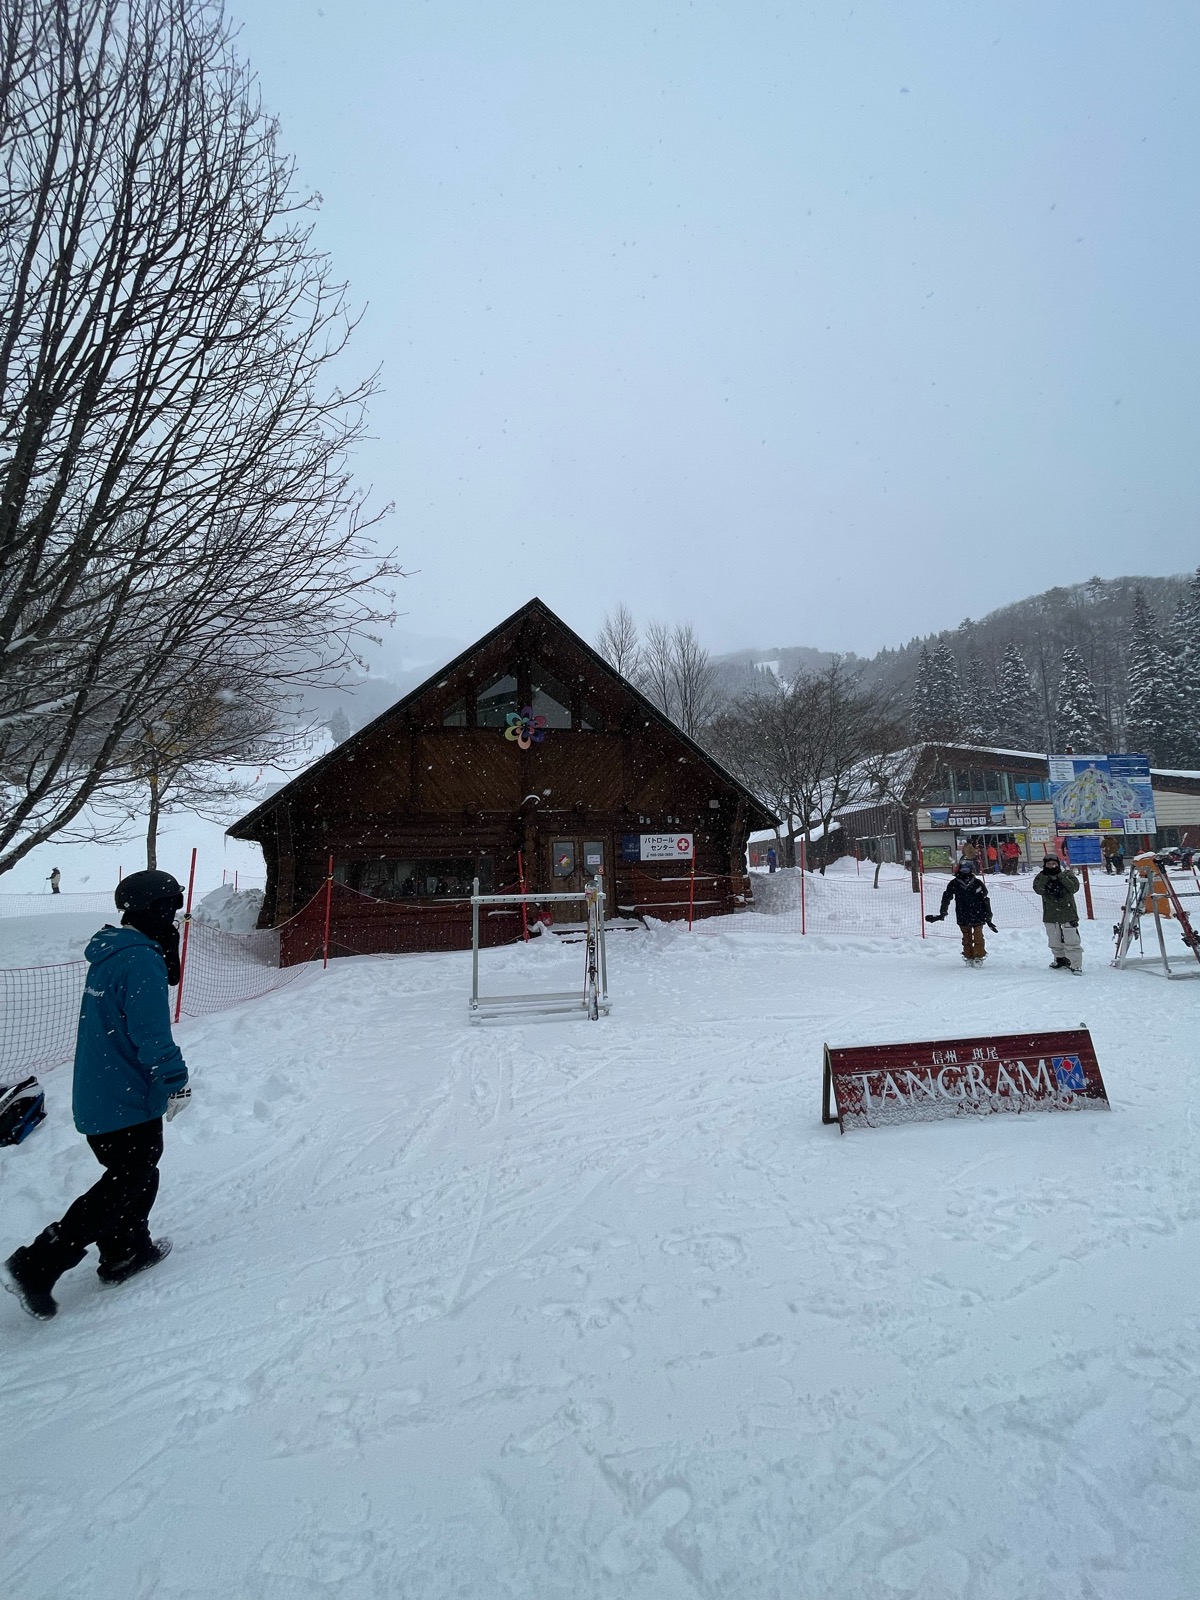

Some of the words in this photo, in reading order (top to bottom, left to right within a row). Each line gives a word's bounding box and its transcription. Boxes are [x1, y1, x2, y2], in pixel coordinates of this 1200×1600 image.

[932, 1050, 957, 1065] 信州
[972, 1047, 999, 1060] 斑尾
[851, 1059, 1055, 1110] TANGRAM
